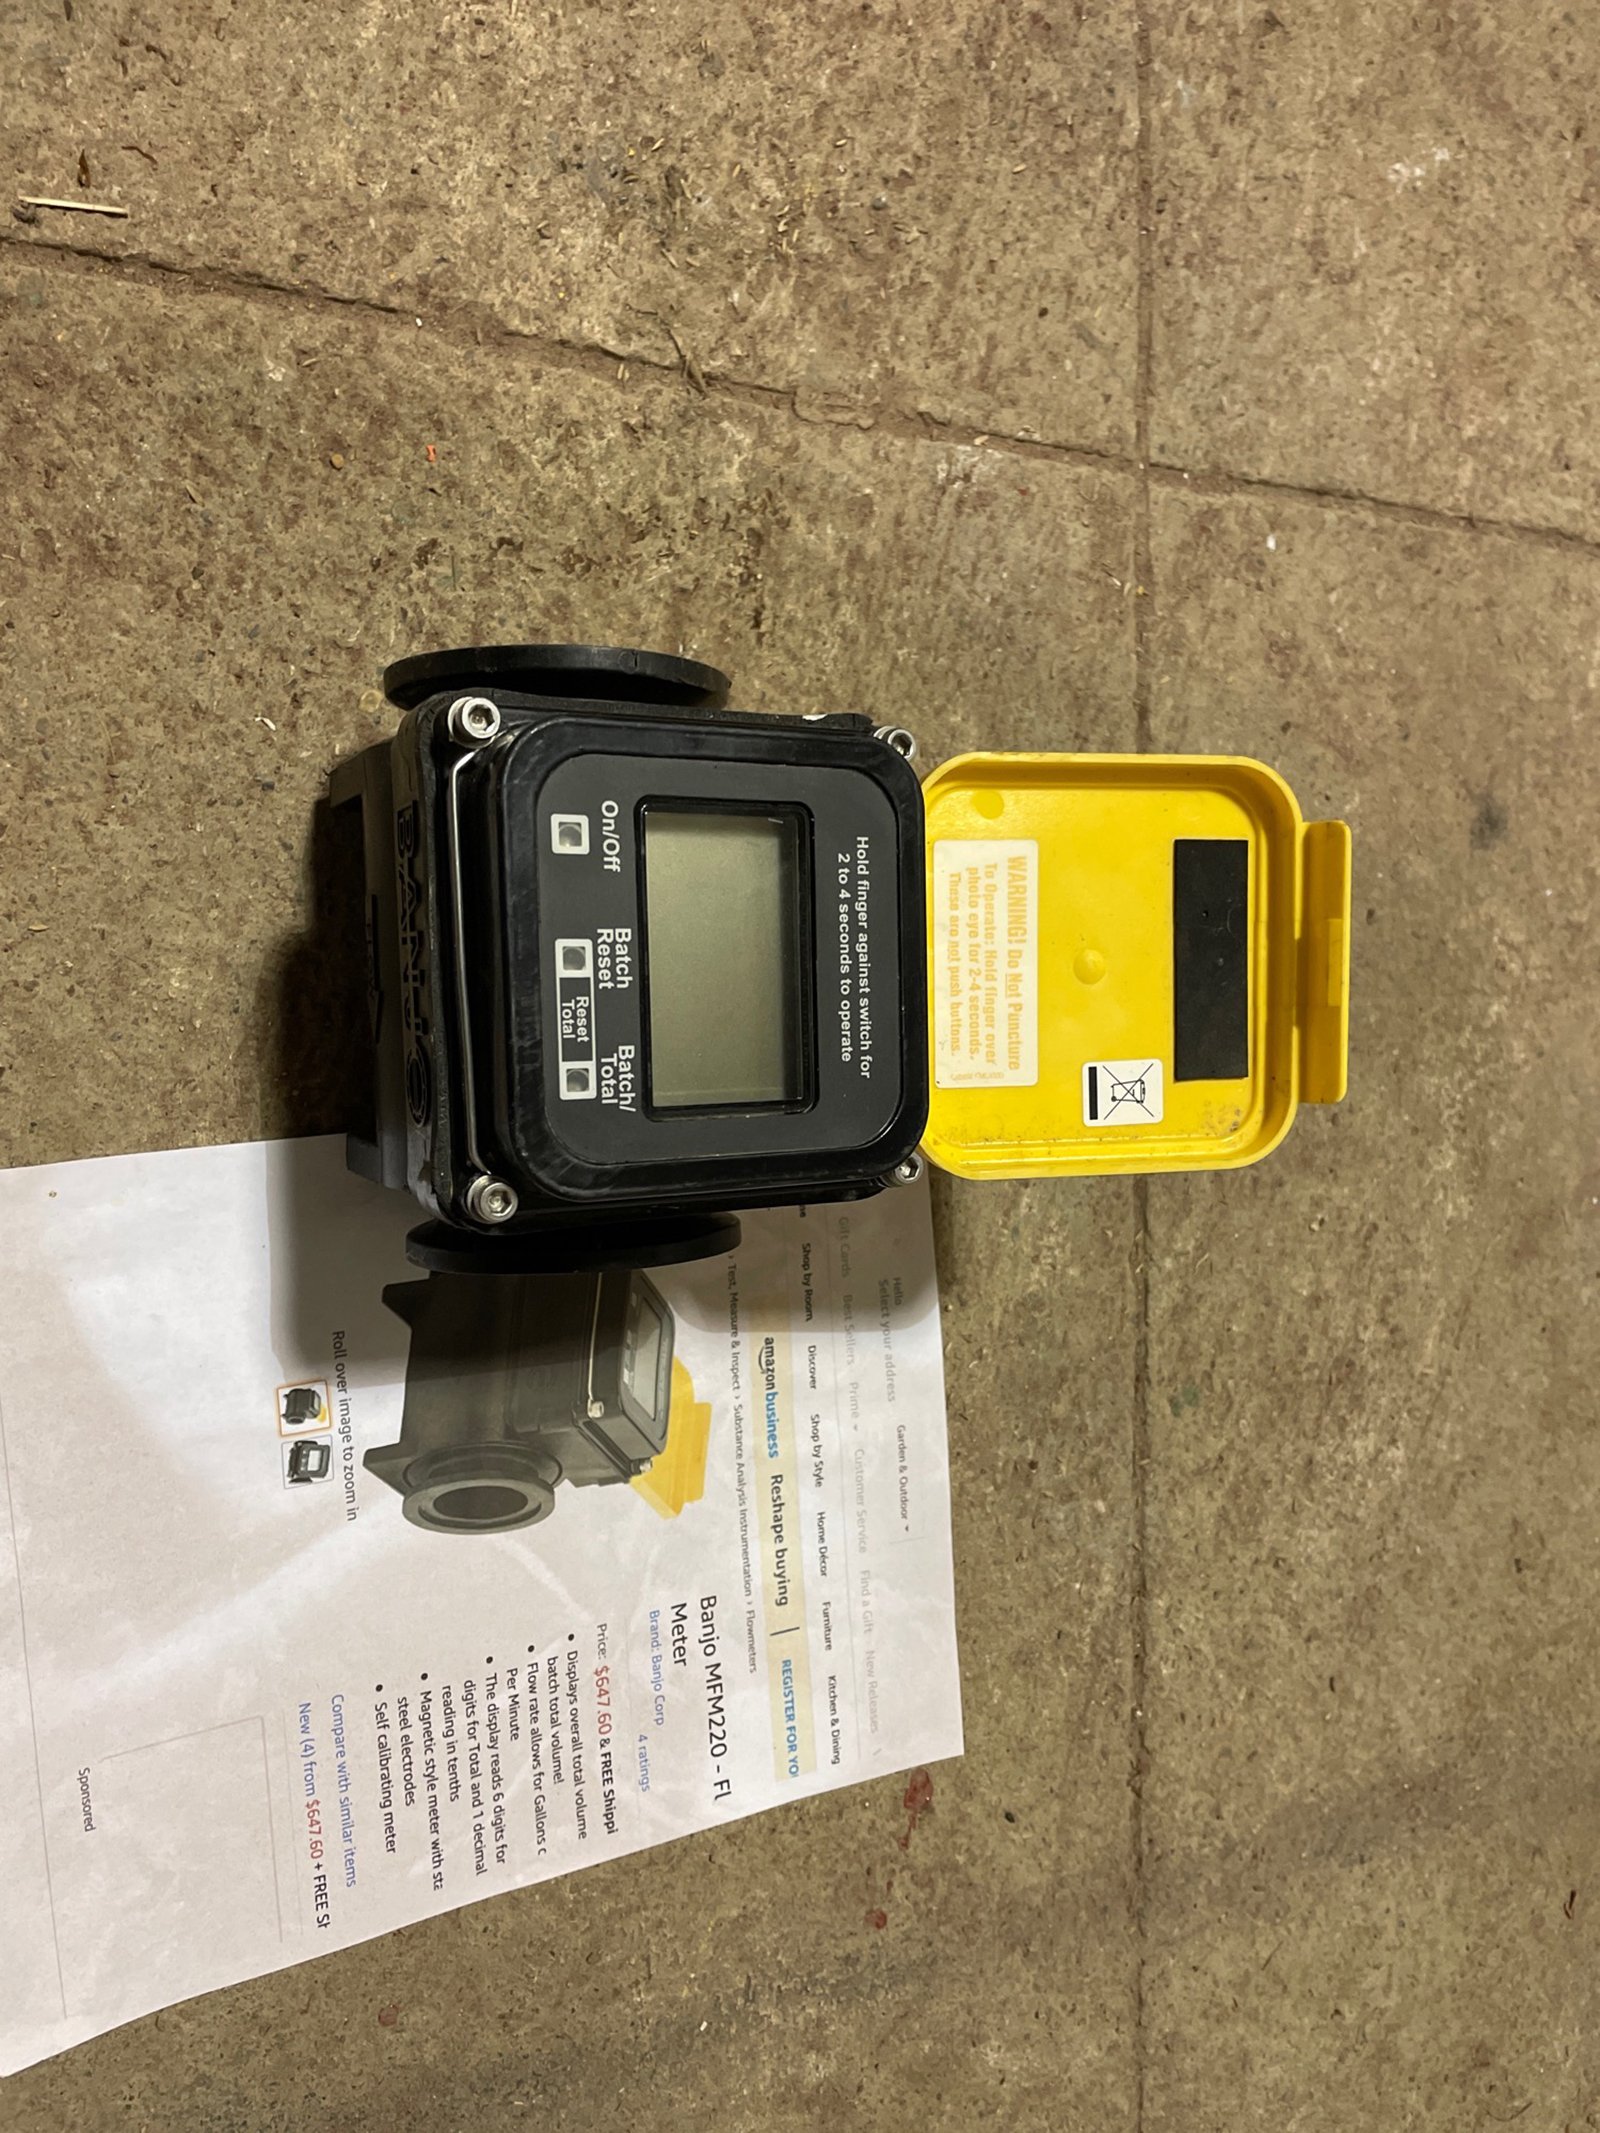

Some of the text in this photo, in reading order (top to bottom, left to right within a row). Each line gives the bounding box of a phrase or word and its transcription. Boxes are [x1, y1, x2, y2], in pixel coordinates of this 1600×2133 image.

[601, 800, 620, 872] On/Off
[396, 801, 431, 1126] BANJO
[597, 929, 615, 990] Reset
[615, 928, 633, 989] Batch
[838, 853, 854, 1062] 2 to 4 seconds to operate
[854, 836, 873, 1078] Hold finger against switch for
[948, 872, 963, 1056] These are not push buttons.
[966, 867, 981, 1060] photo eye for 2-4 seconds.
[982, 863, 998, 1065] To Operate: Hold finger over
[1006, 856, 1027, 1070] WARNING! Do Not Puncture
[561, 999, 576, 1039] Total
[576, 997, 590, 1043] Reset
[600, 1053, 617, 1105] Total
[617, 1045, 635, 1112] Batch/
[839, 1217, 851, 1278] Gift Cards
[800, 1243, 814, 1321] Shop by Room
[893, 1277, 903, 1305] Hello
[727, 1264, 741, 1390] Test, Measure & Inspect
[842, 1295, 856, 1365] Best Sellers
[878, 1279, 897, 1402] Select your address
[807, 1345, 818, 1389] Discover
[332, 1331, 359, 1521] Roll over image to zoom in
[848, 1382, 861, 1419] Prime
[809, 1414, 824, 1488] Shop by Style
[897, 1425, 909, 1519] Garden & Outdoor
[733, 1404, 753, 1596] Substance Analysis Instrumentation
[854, 1449, 869, 1553] Customer Service
[770, 1475, 790, 1607] Reshape buying
[816, 1512, 829, 1577] Home Décor
[859, 1570, 871, 1596] Find
[596, 1623, 610, 1660] Price:
[670, 1603, 690, 1667] Meter
[698, 1595, 719, 1657] Banjo
[746, 1610, 759, 1673] Flowmeters
[822, 1602, 833, 1651] Furniture
[862, 1610, 873, 1634] Gift
[526, 1662, 540, 1694] Flow
[593, 1665, 613, 1735] $647.60
[648, 1610, 668, 1726] Brand: Banjo Corp
[865, 1650, 880, 1734] New Releases
[298, 1703, 314, 1735] New
[416, 1691, 436, 1755] Magnetic
[506, 1668, 523, 1741] Per Minute
[529, 1698, 541, 1724] rate
[547, 1657, 566, 1784] batch total volume!
[705, 1663, 728, 1758] MFM220
[782, 1659, 799, 1778] REGISTER FOR YO
[827, 1675, 842, 1765] Kitchen & Dining
[301, 1738, 316, 1758] (4)
[396, 1697, 417, 1807] steel electrodes
[420, 1758, 437, 1791] style
[437, 1685, 462, 1802] reading in tenths
[483, 1673, 508, 1864] The display reads 6 digits for
[530, 1728, 545, 1768] allows
[563, 1650, 590, 1839] Displays overall total volume
[599, 1738, 612, 1750] &
[601, 1752, 615, 1786] FREE
[636, 1734, 653, 1792] 4 ratings
[77, 1767, 95, 1832] Sponsored
[304, 1761, 319, 1796] from
[330, 1694, 358, 1888] Compare with similar items
[373, 1703, 398, 1853] Self calibrating meter
[461, 1680, 488, 1875] digits for Total and 1 decimal
[533, 1771, 546, 1791] for
[305, 1800, 325, 1860] $647.60
[426, 1795, 440, 1835] meter
[533, 1795, 549, 1845] Gallons
[430, 1839, 445, 1869] with
[312, 1875, 328, 1911] FREE
